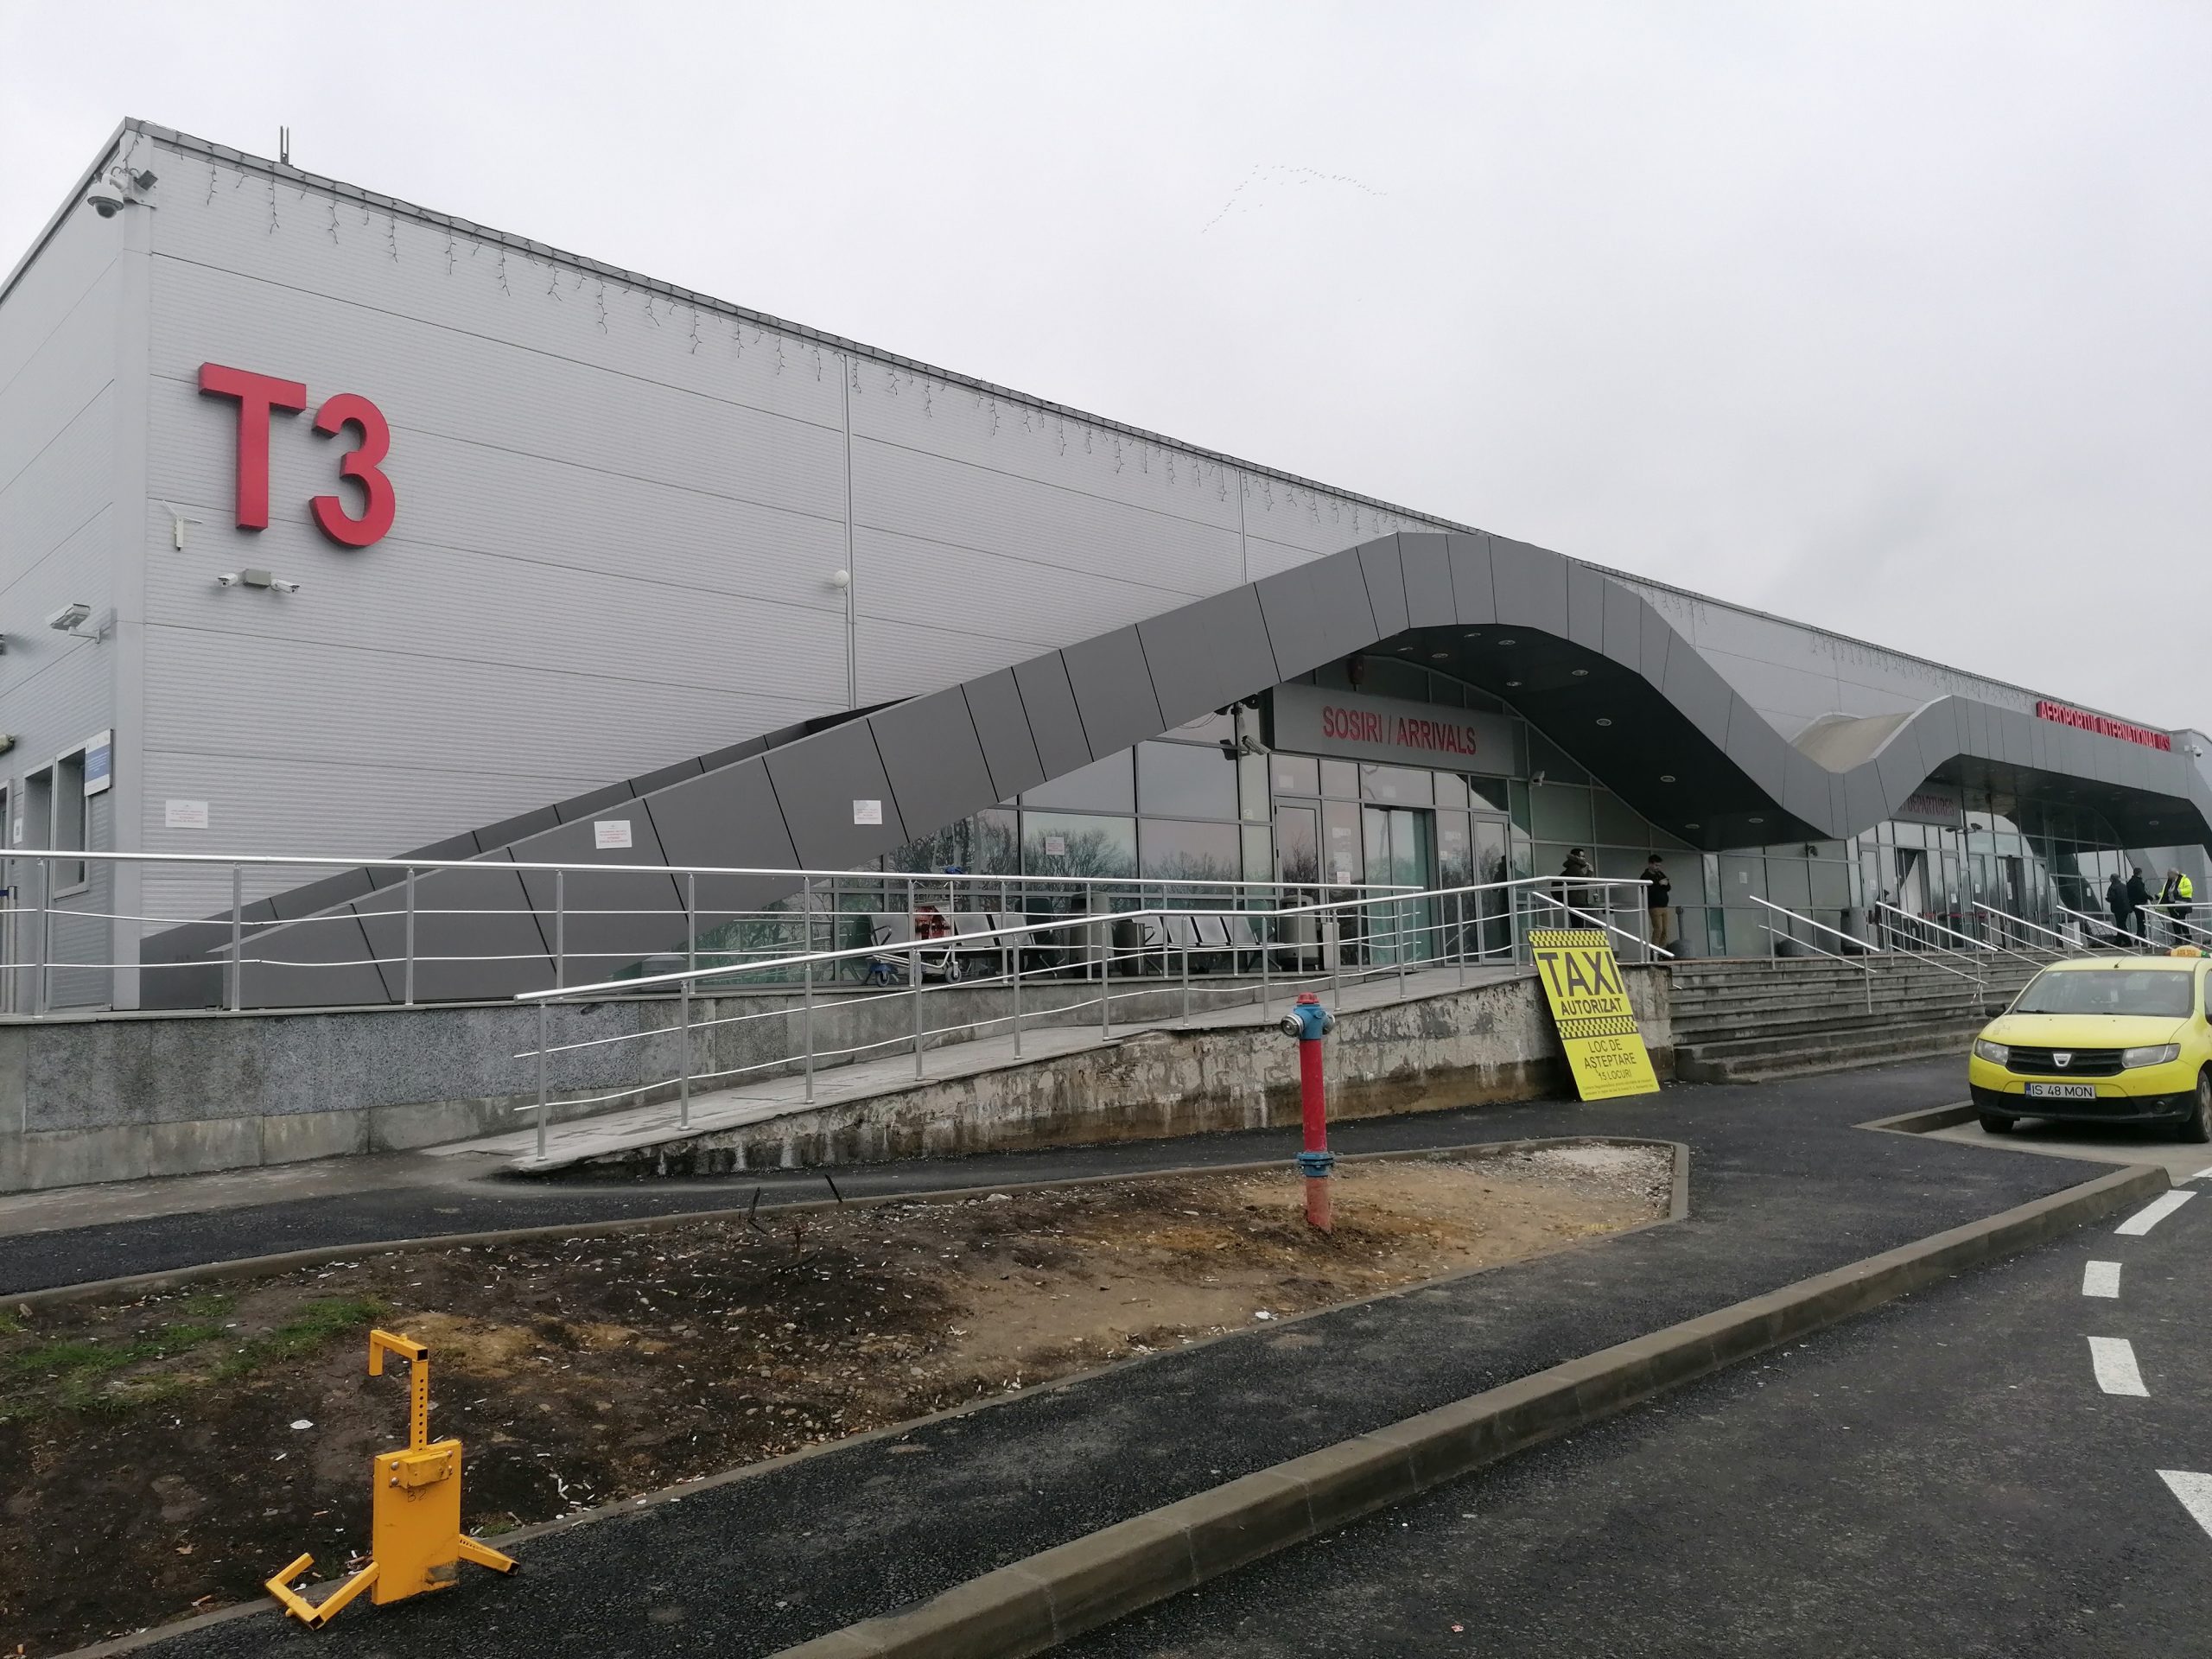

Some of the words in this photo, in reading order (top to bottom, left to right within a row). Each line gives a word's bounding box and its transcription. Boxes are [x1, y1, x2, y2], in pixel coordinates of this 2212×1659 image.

[198, 361, 396, 547] T3
[1323, 705, 1382, 744] SOSIRI
[1396, 717, 1477, 755] ARRIVALS
[2037, 701, 2097, 733] AEROPORTUL
[2099, 716, 2157, 749] INTERNATIONAL
[1537, 950, 1624, 997] TAXI
[1560, 998, 1623, 1016] AUTORIZAT
[1588, 1040, 1608, 1053] LOC
[1609, 1039, 1623, 1051] DE
[1599, 1071, 1607, 1081] 15
[1607, 1069, 1632, 1080] LOCURI
[2031, 1084, 2043, 1096] IS
[2047, 1085, 2062, 1096] 48
[2064, 1085, 2093, 1097] MON
